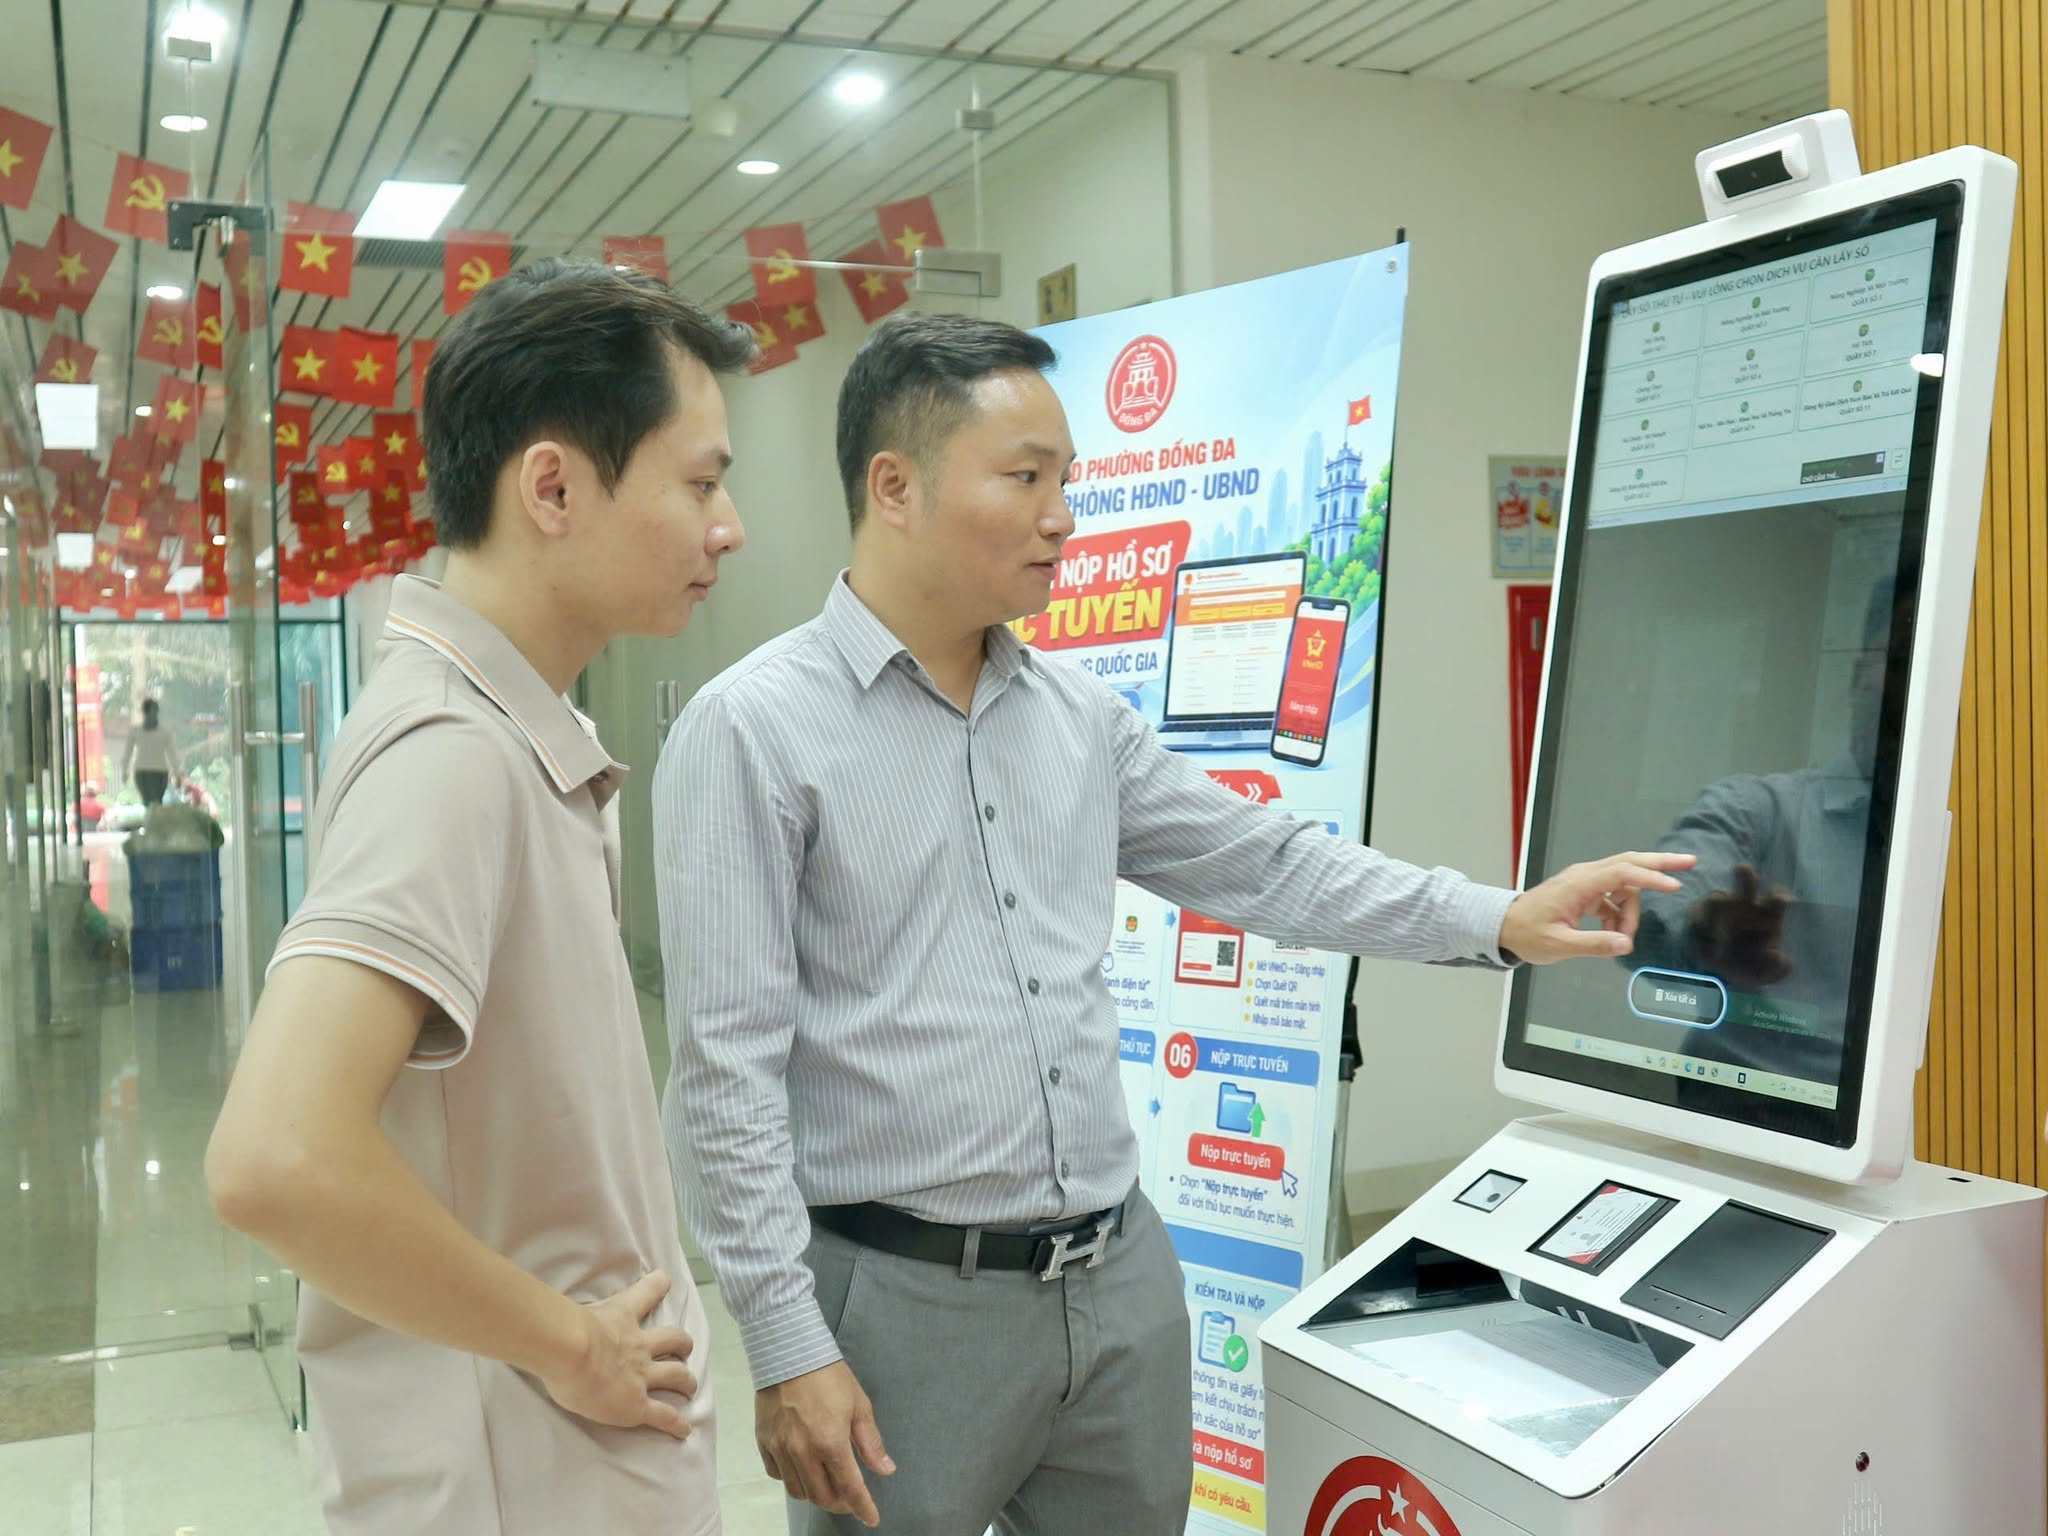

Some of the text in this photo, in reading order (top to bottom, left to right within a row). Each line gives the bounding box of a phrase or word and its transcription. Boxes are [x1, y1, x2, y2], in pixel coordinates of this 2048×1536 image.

[1855, 243, 1870, 259] SỐ
[1086, 448, 1154, 481] PHƯỜNG
[1158, 438, 1207, 470] ĐỐNG
[1212, 437, 1236, 463] ĐA
[1131, 478, 1186, 511] HĐND
[1203, 467, 1260, 501] UBND
[1059, 538, 1174, 593] NỘP HỒ SƠ
[1045, 578, 1163, 640] TUYẾN
[1095, 649, 1132, 676] QUỐC
[1135, 652, 1158, 672] GIA
[1136, 1041, 1151, 1057] TỤC
[1169, 1042, 1192, 1068] 06
[1211, 1047, 1288, 1073] NỘP TRỰC TUYẾN
[1201, 1143, 1271, 1169] Nộp trực tuyến
[1180, 1174, 1199, 1189] Chọn
[1222, 1182, 1239, 1197] trực
[1195, 1281, 1266, 1312] KIỂM TRA VÀ NỘP
[1237, 1402, 1257, 1420] trách
[1204, 1443, 1223, 1463] nộp
[1239, 1456, 1253, 1471] sơ
[1208, 1487, 1217, 1501] có
[1219, 1491, 1234, 1507] yêu
